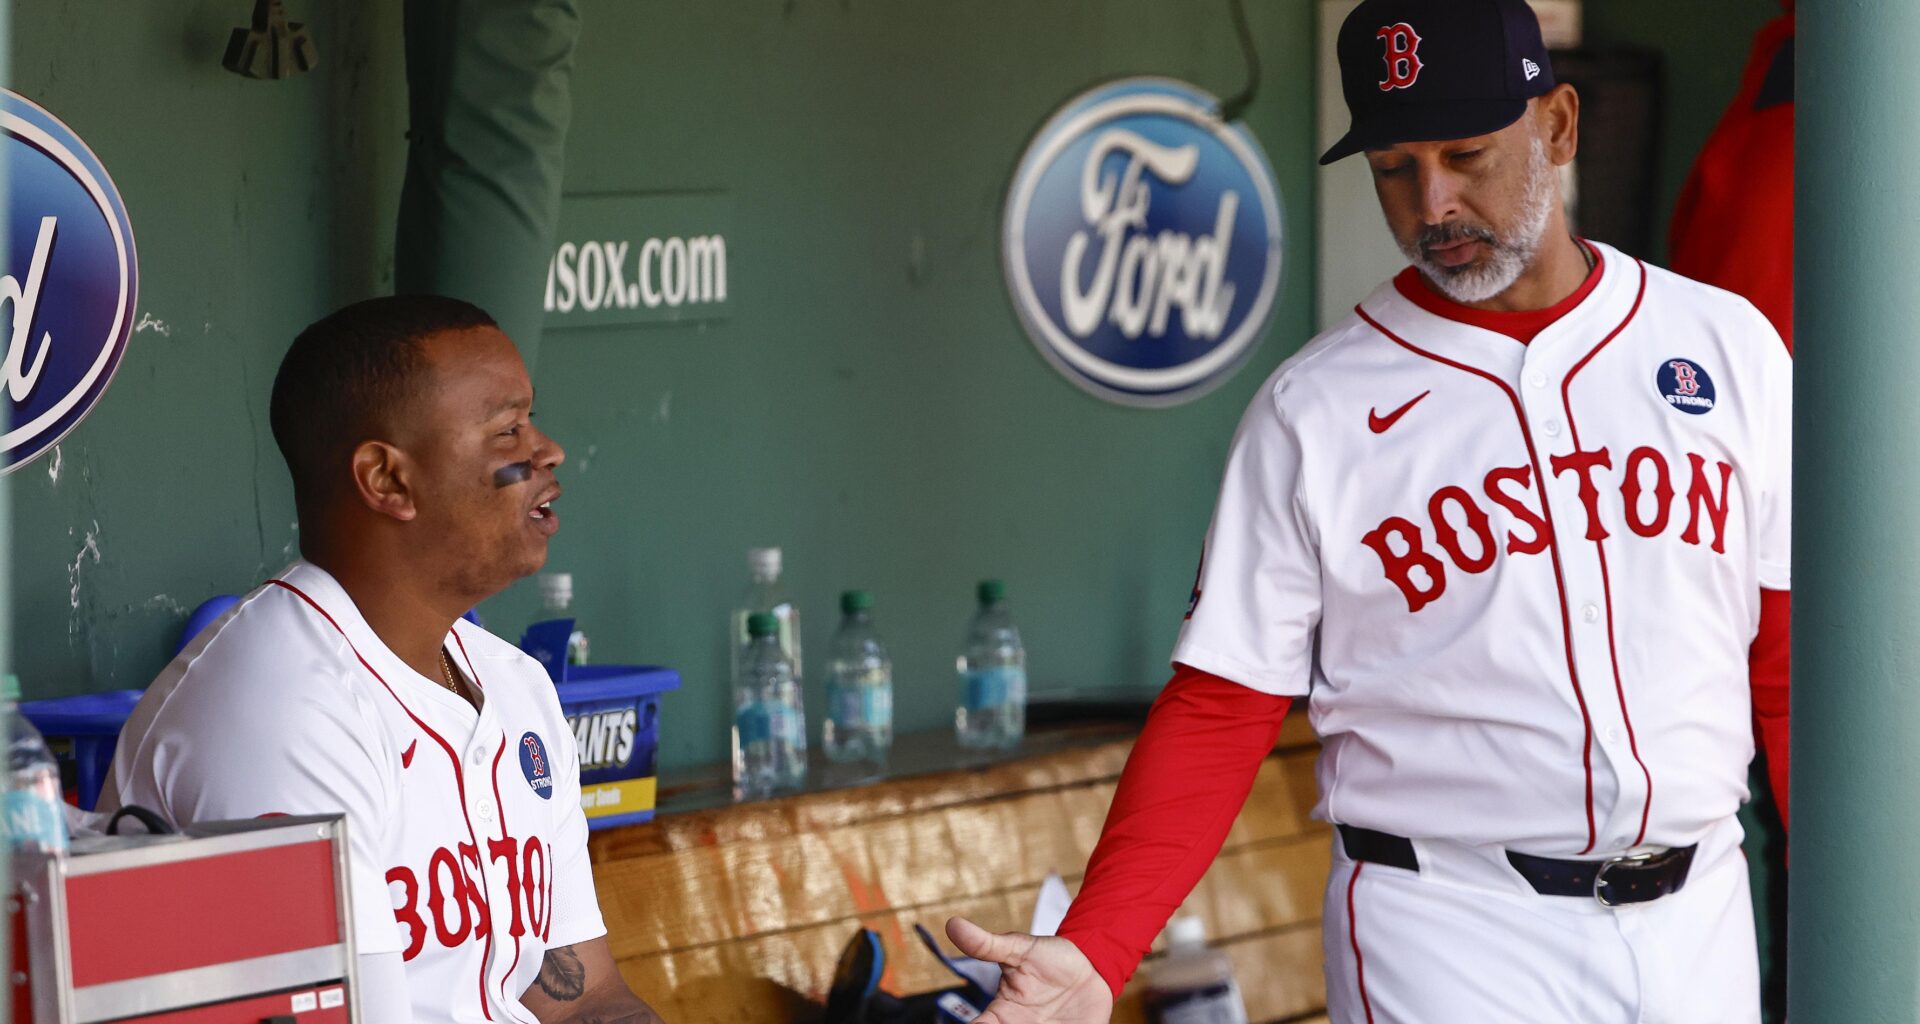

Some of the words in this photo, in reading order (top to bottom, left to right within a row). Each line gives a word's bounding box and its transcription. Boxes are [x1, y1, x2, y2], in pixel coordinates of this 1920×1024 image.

[1376, 22, 1424, 91] B
[1060, 127, 1239, 338] Ford
[1666, 394, 1714, 408] STRONG
[1669, 361, 1700, 396] B
[1361, 446, 1732, 612] BOSTON
[524, 736, 544, 776] B
[385, 836, 552, 962] BOSTO
